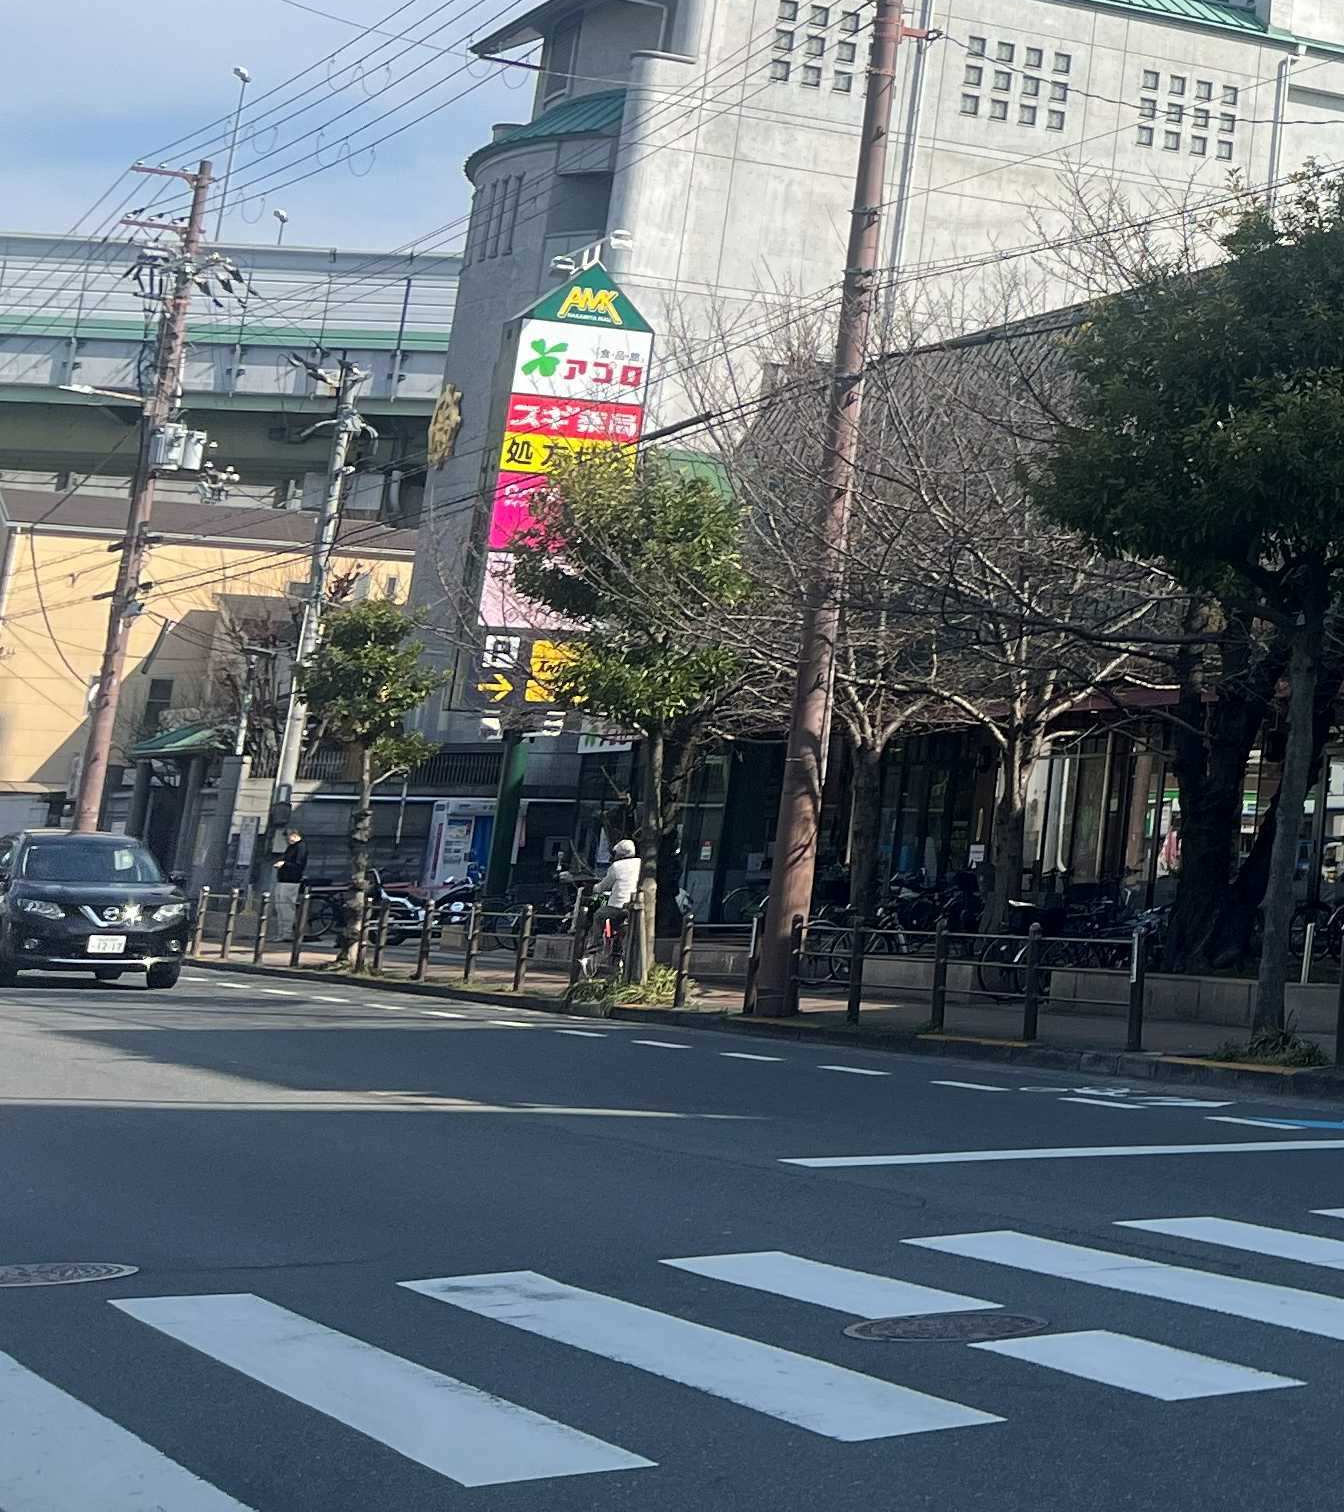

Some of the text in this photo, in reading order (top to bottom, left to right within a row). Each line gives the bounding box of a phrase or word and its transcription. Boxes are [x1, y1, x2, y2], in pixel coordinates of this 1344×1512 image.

[563, 359, 643, 387] アプロ
[510, 404, 637, 437] スギ薬局
